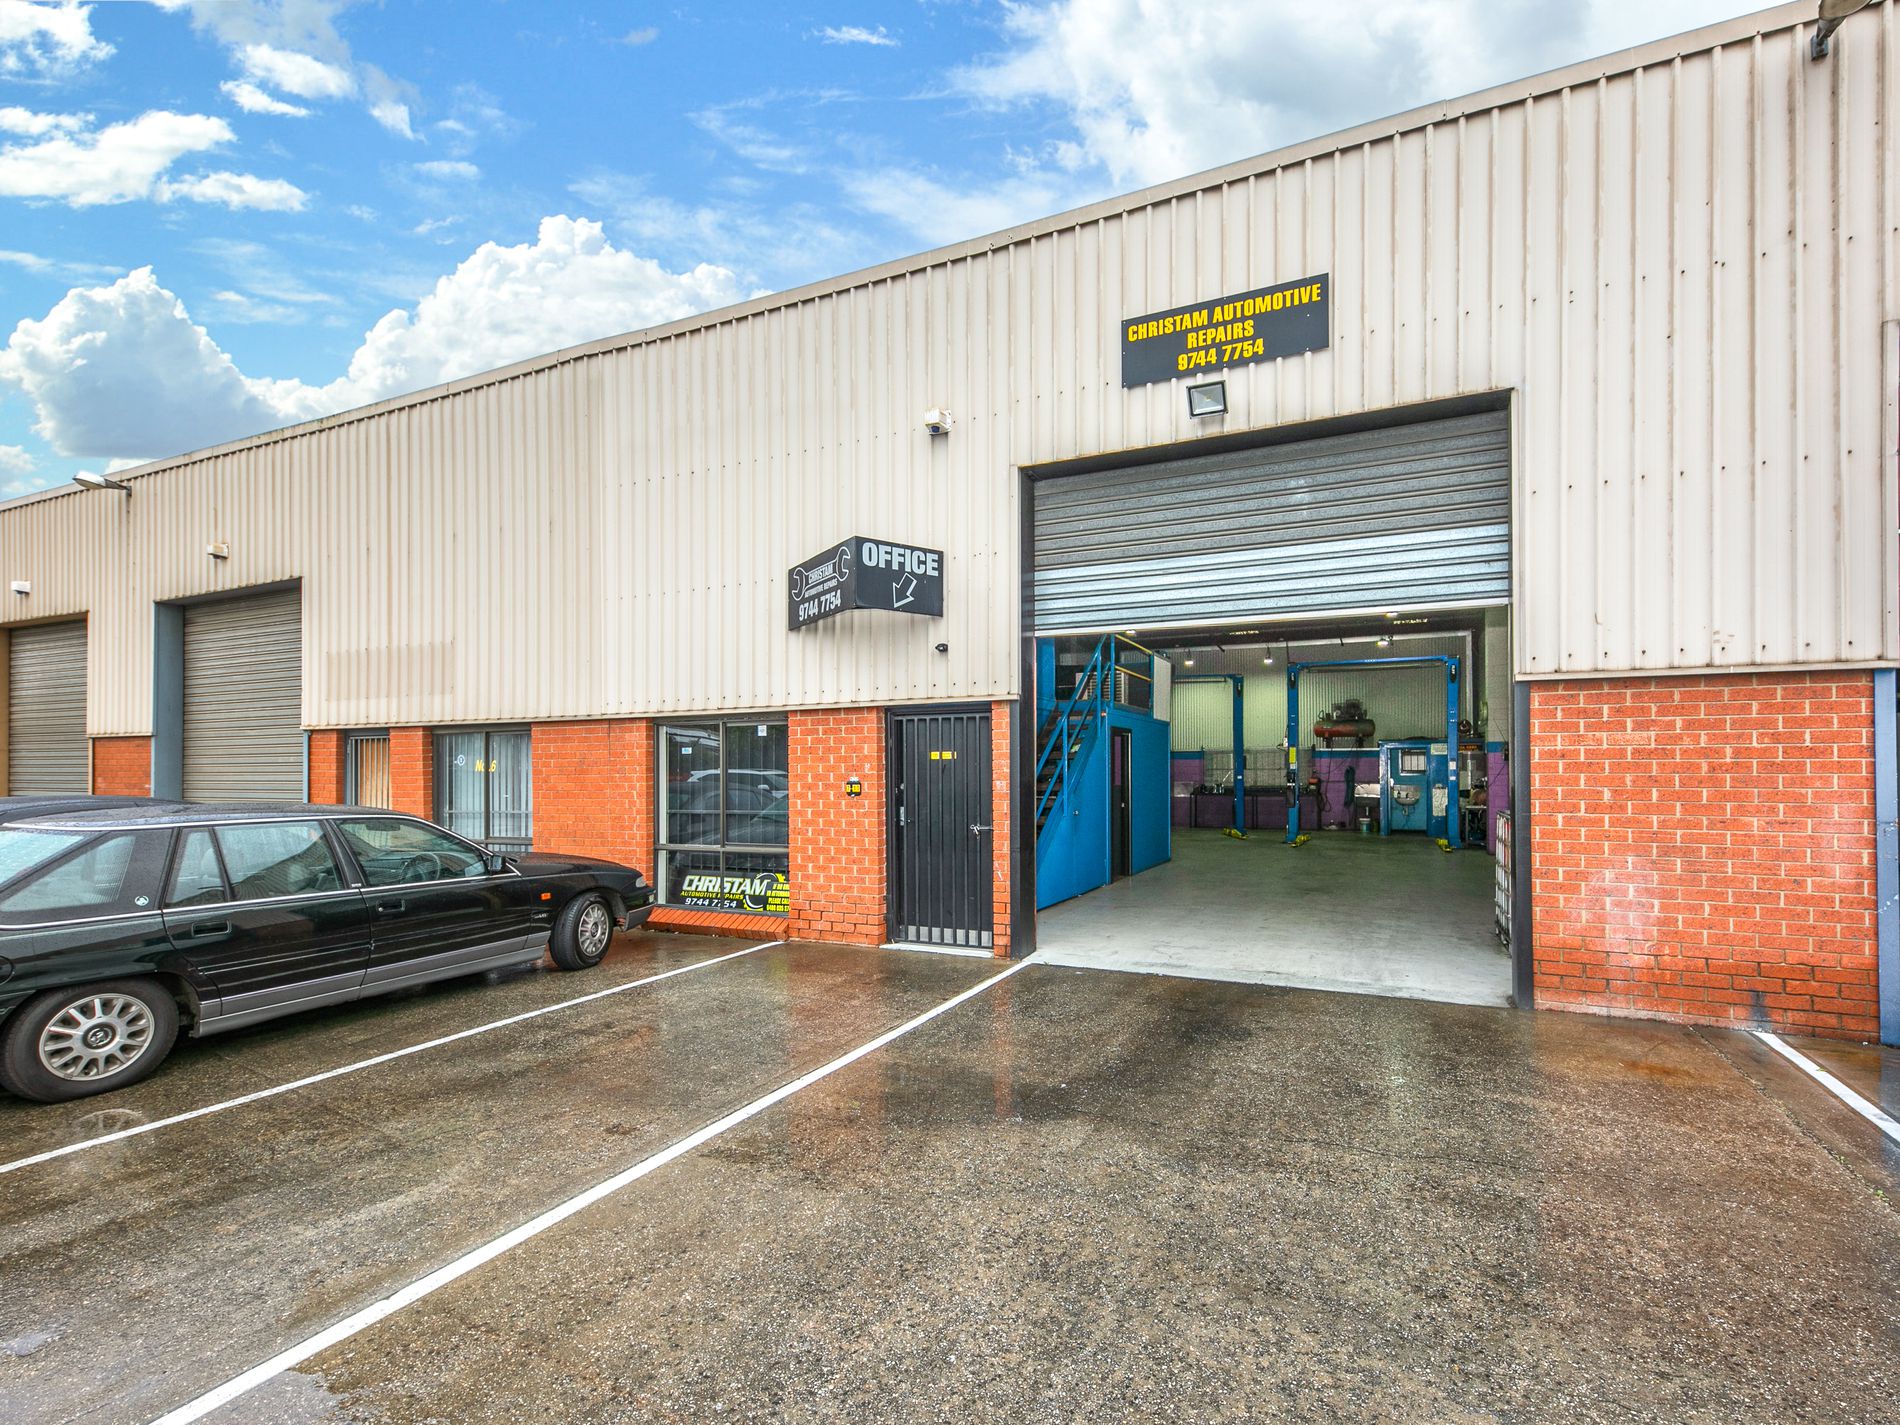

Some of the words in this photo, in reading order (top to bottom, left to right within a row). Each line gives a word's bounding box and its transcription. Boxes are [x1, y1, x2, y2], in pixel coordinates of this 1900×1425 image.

[1127, 308, 1209, 342] CHRISTAM
[1212, 283, 1322, 324] AUTOMOTIVE
[1186, 319, 1255, 349] REPAIRS
[1176, 347, 1217, 371] 9744
[1221, 338, 1265, 362] 7754
[808, 563, 834, 584] CHRISTAM
[861, 541, 939, 577] OFFICE
[798, 598, 819, 621] 9744
[820, 589, 842, 613] 7754
[682, 875, 771, 895] CHRISTAM
[685, 897, 709, 906] 9744
